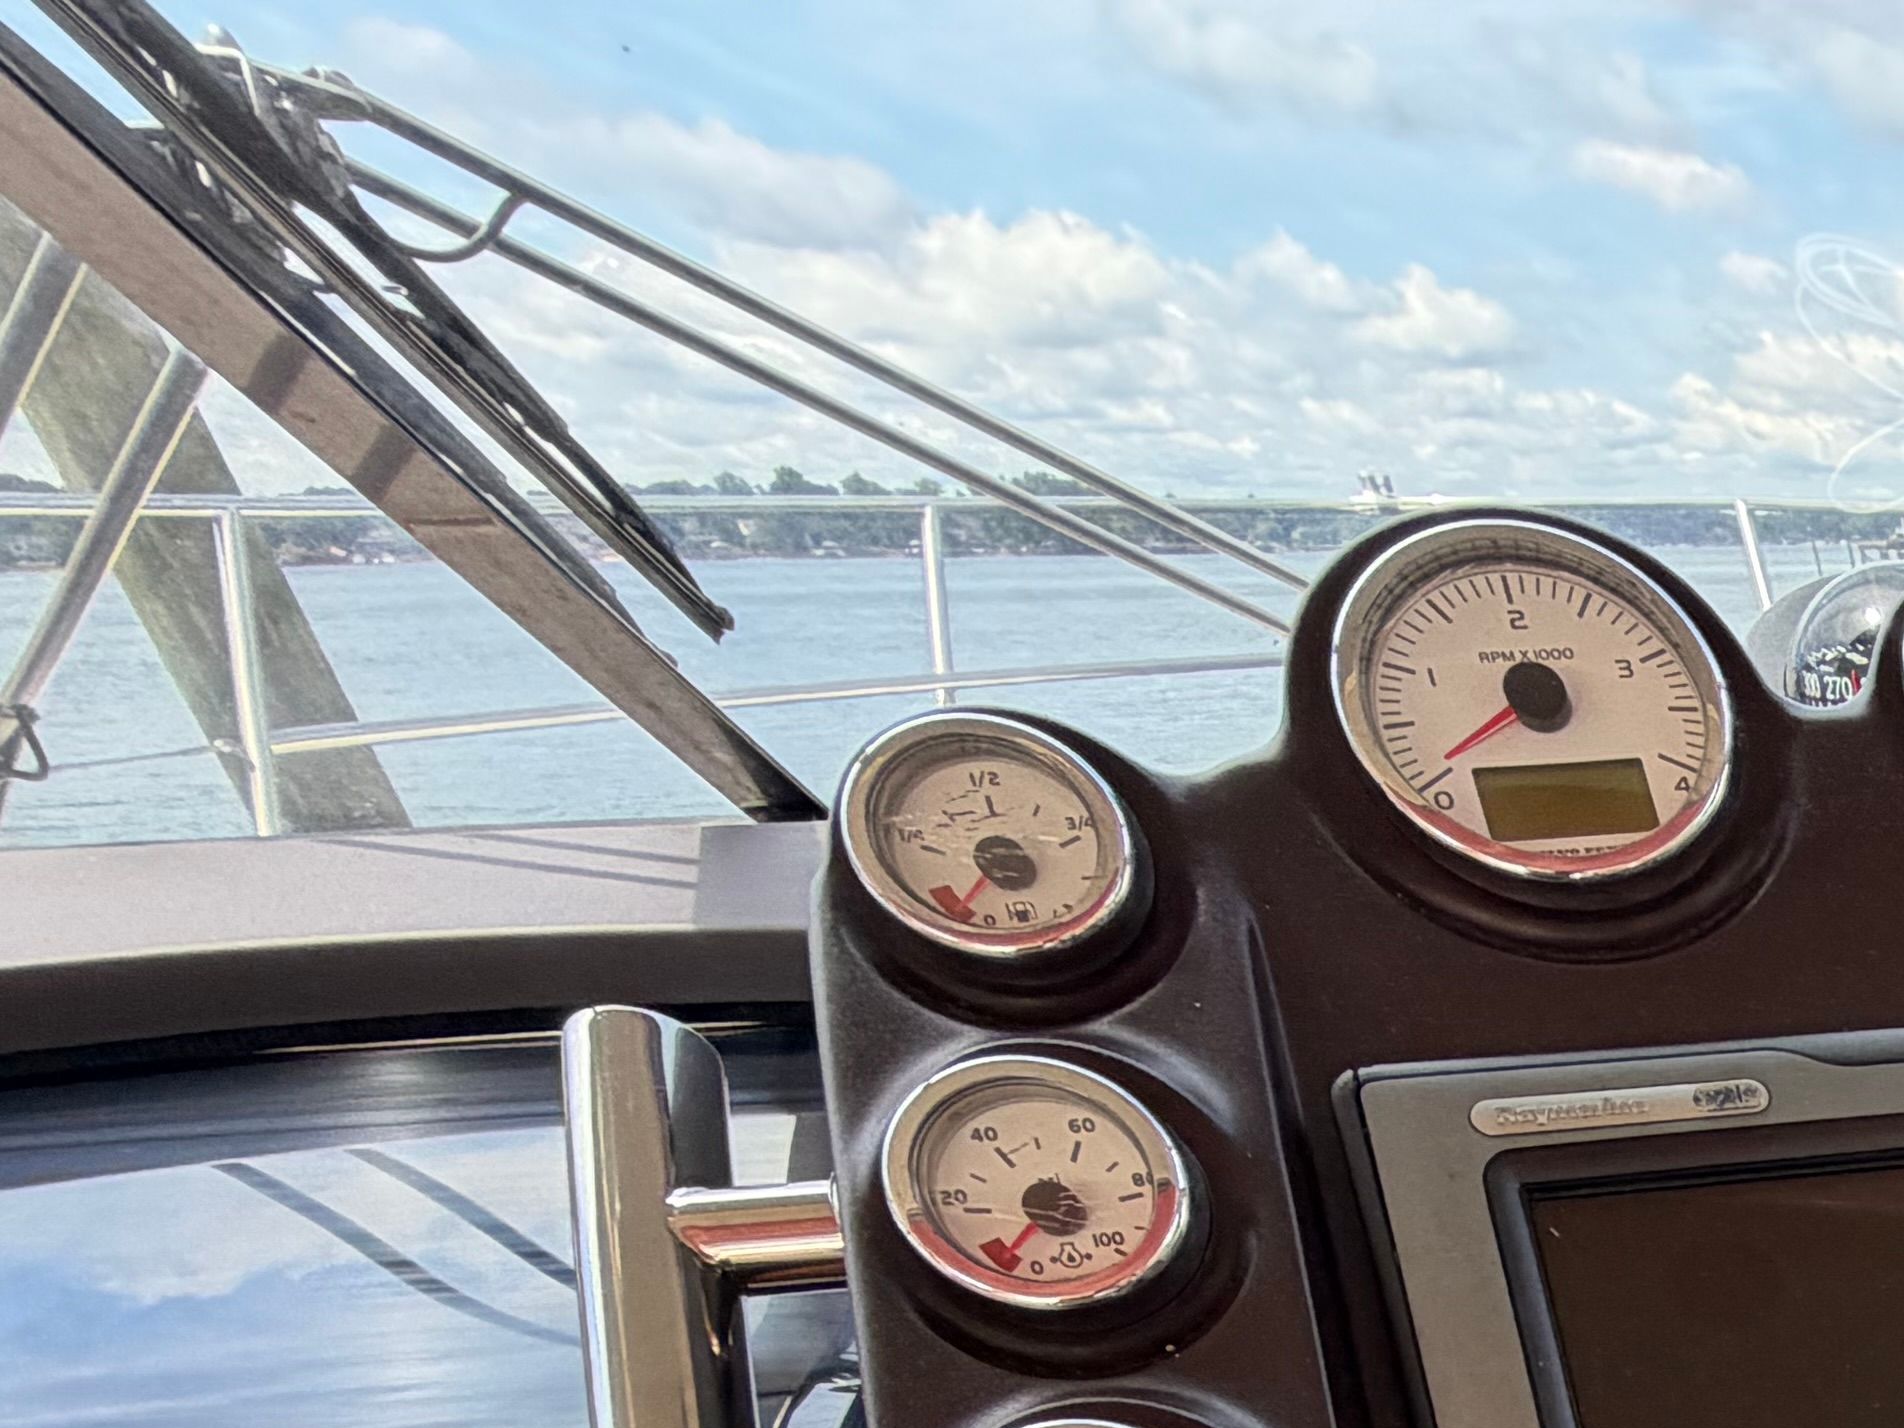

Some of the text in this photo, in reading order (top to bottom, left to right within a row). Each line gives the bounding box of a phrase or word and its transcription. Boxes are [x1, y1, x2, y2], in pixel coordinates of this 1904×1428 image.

[1507, 610, 1528, 630] 2
[1478, 650, 1516, 664] RPM
[1533, 647, 1575, 661] 1000
[1427, 667, 1437, 687] 1
[1614, 658, 1635, 679] 3
[969, 771, 1001, 788] 1/2
[1674, 775, 1691, 794] 4
[1434, 791, 1455, 811] 0
[983, 913, 996, 927] 0
[969, 1126, 999, 1142] 40
[1067, 1117, 1096, 1134] 60
[940, 1189, 968, 1207] 20
[1091, 1231, 1125, 1248] 100
[1030, 1260, 1045, 1276] 0
